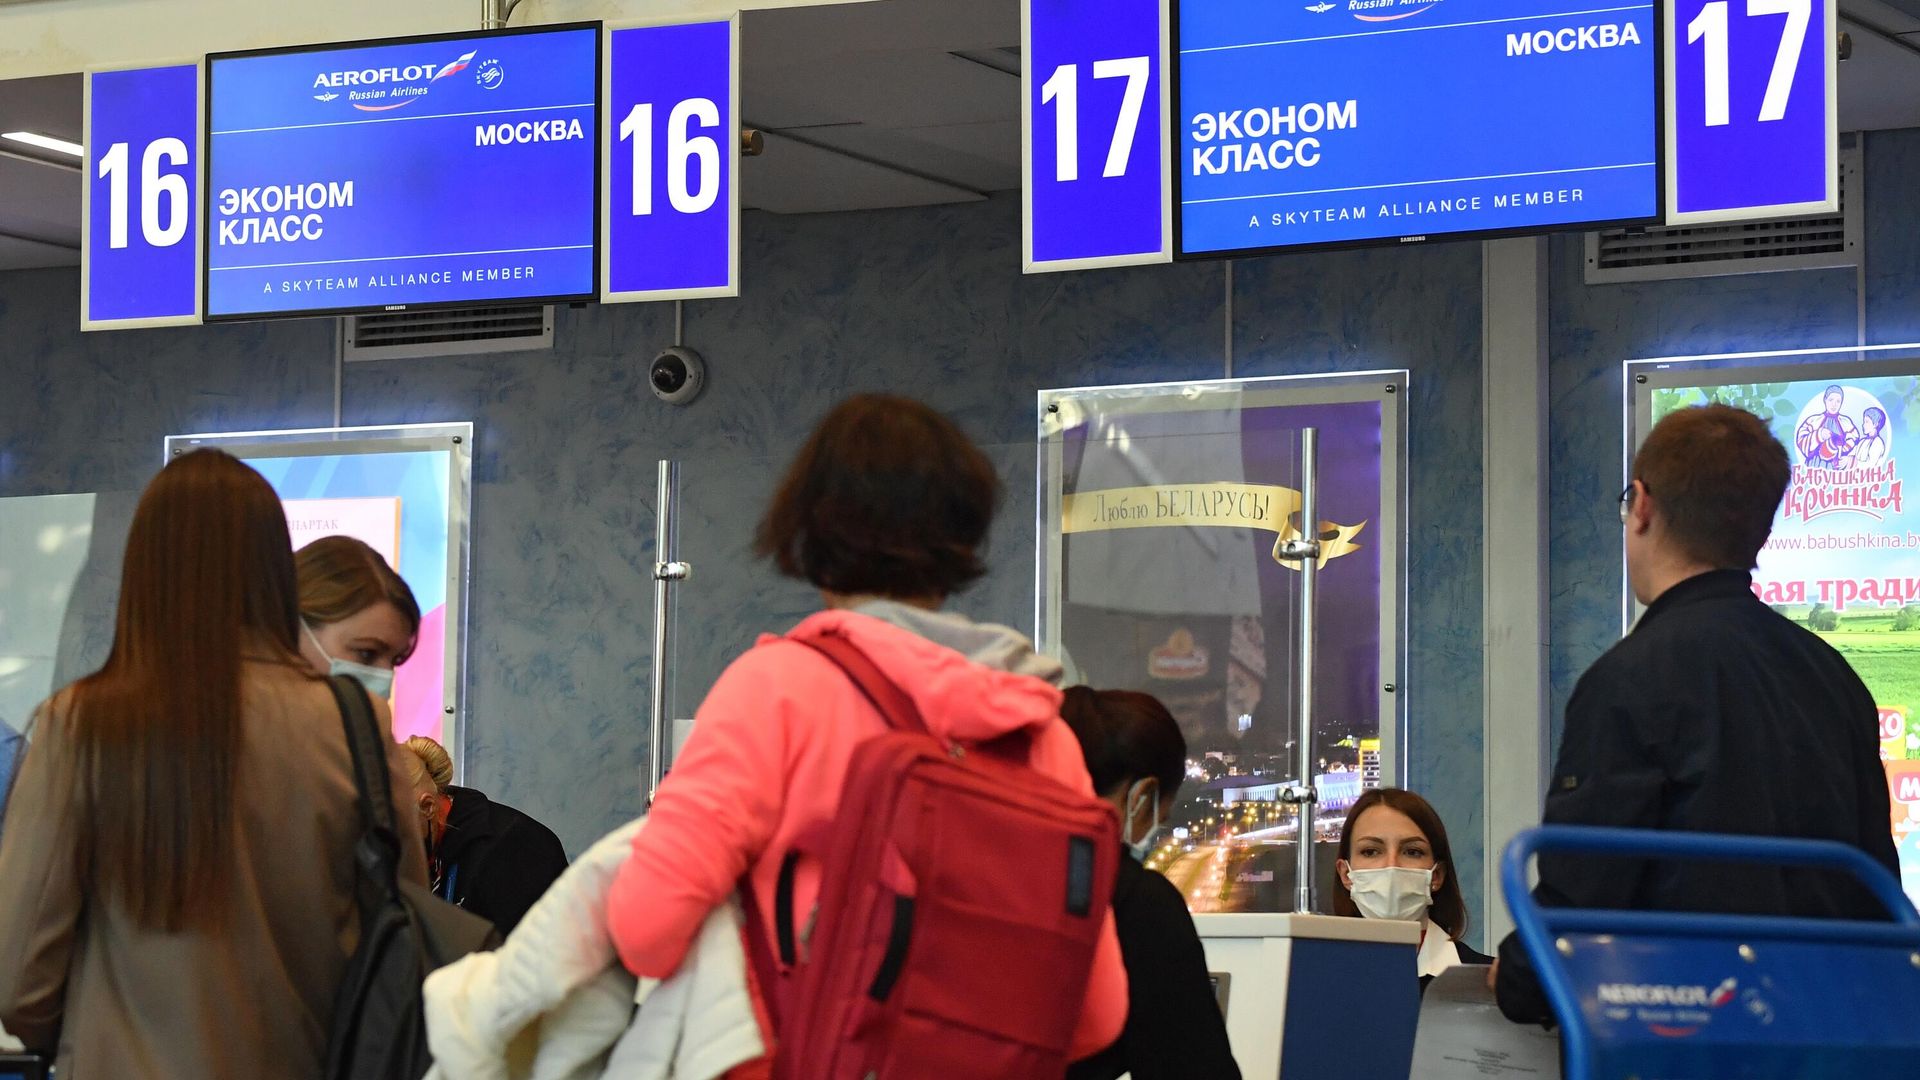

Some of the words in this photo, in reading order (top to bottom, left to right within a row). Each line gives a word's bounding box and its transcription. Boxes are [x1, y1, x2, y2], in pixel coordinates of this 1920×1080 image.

[1506, 22, 1641, 57] МОСКВА
[313, 64, 437, 88] AEROFLOT
[1687, 0, 1812, 127] 17
[349, 89, 386, 101] Russian
[390, 86, 428, 97] Airlines
[475, 118, 584, 147] МОСКВА
[1040, 56, 1150, 183] 17
[1191, 99, 1357, 142] ЭКОНОМ
[618, 97, 721, 216] 16
[1192, 137, 1321, 176] КЛАСС
[98, 136, 189, 249] 16
[219, 180, 354, 216] ЭКОНОМ
[1249, 215, 1260, 228] A
[1271, 206, 1366, 226] SKYTEAM
[1378, 197, 1481, 217] ALLIANCE
[1493, 188, 1584, 208] MEMBER
[219, 213, 324, 246] КЛАСС
[263, 282, 273, 294] A
[282, 276, 359, 293] SKYTEAM
[368, 271, 452, 287] ALLIANCE
[462, 266, 535, 282] MEMBER
[1792, 460, 1895, 486] БАБУШКИНА
[1093, 494, 1149, 522] Люблю
[1155, 490, 1270, 521] БЕЛАРУСЬ!
[1783, 480, 1903, 521] КРЫНКА
